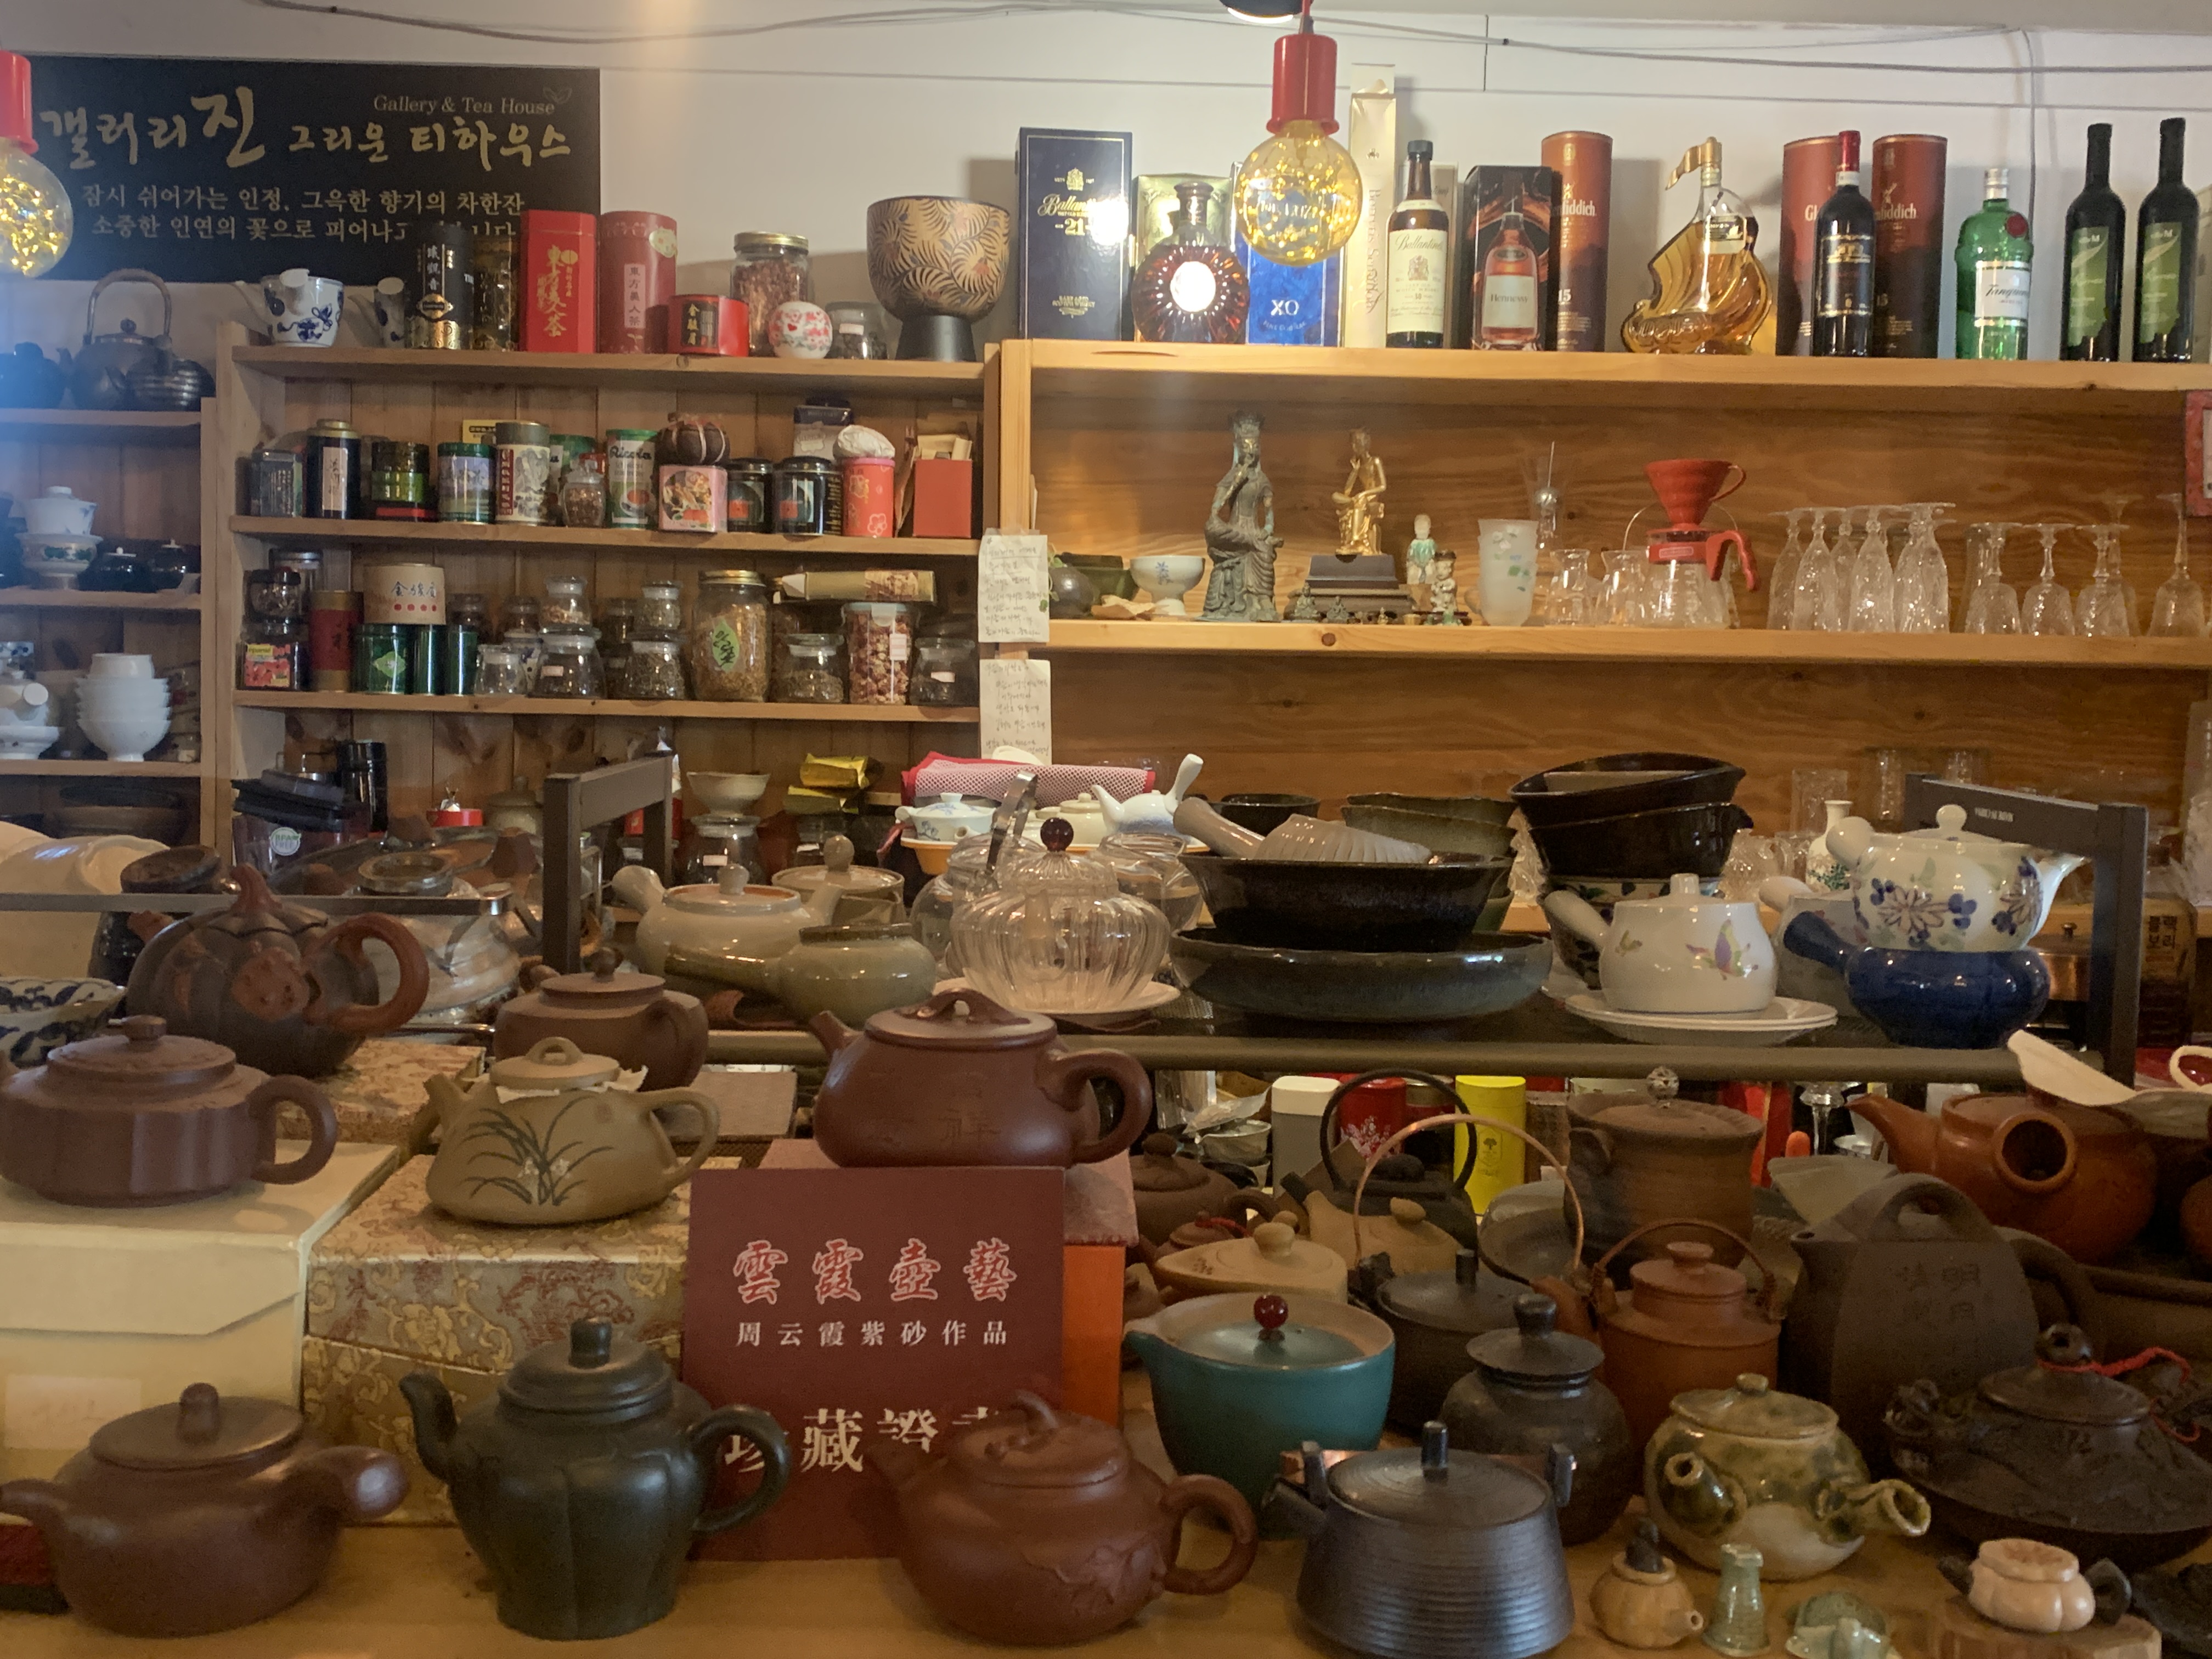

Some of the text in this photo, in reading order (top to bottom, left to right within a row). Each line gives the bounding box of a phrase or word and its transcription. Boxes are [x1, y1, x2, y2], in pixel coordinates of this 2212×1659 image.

[374, 95, 555, 115] Gallery & Tea House
[289, 122, 388, 162] 그리운
[410, 116, 571, 171] 티하우스
[83, 184, 126, 208] 잠시
[137, 184, 228, 210] 쉬어가는
[302, 189, 370, 213] 그윽한
[380, 190, 445, 215] 향기의
[457, 192, 525, 216] 차한잔
[92, 215, 161, 238] 소중한
[171, 215, 236, 240] 인연의
[246, 217, 315, 241] 꽃으로
[1064, 218, 1085, 236] 21
[1271, 299, 1300, 317] XO
[1491, 294, 1528, 303] Hennessy
[610, 445, 652, 460] Ricola
[736, 1321, 1008, 1347] 周云霞紫砂作品
